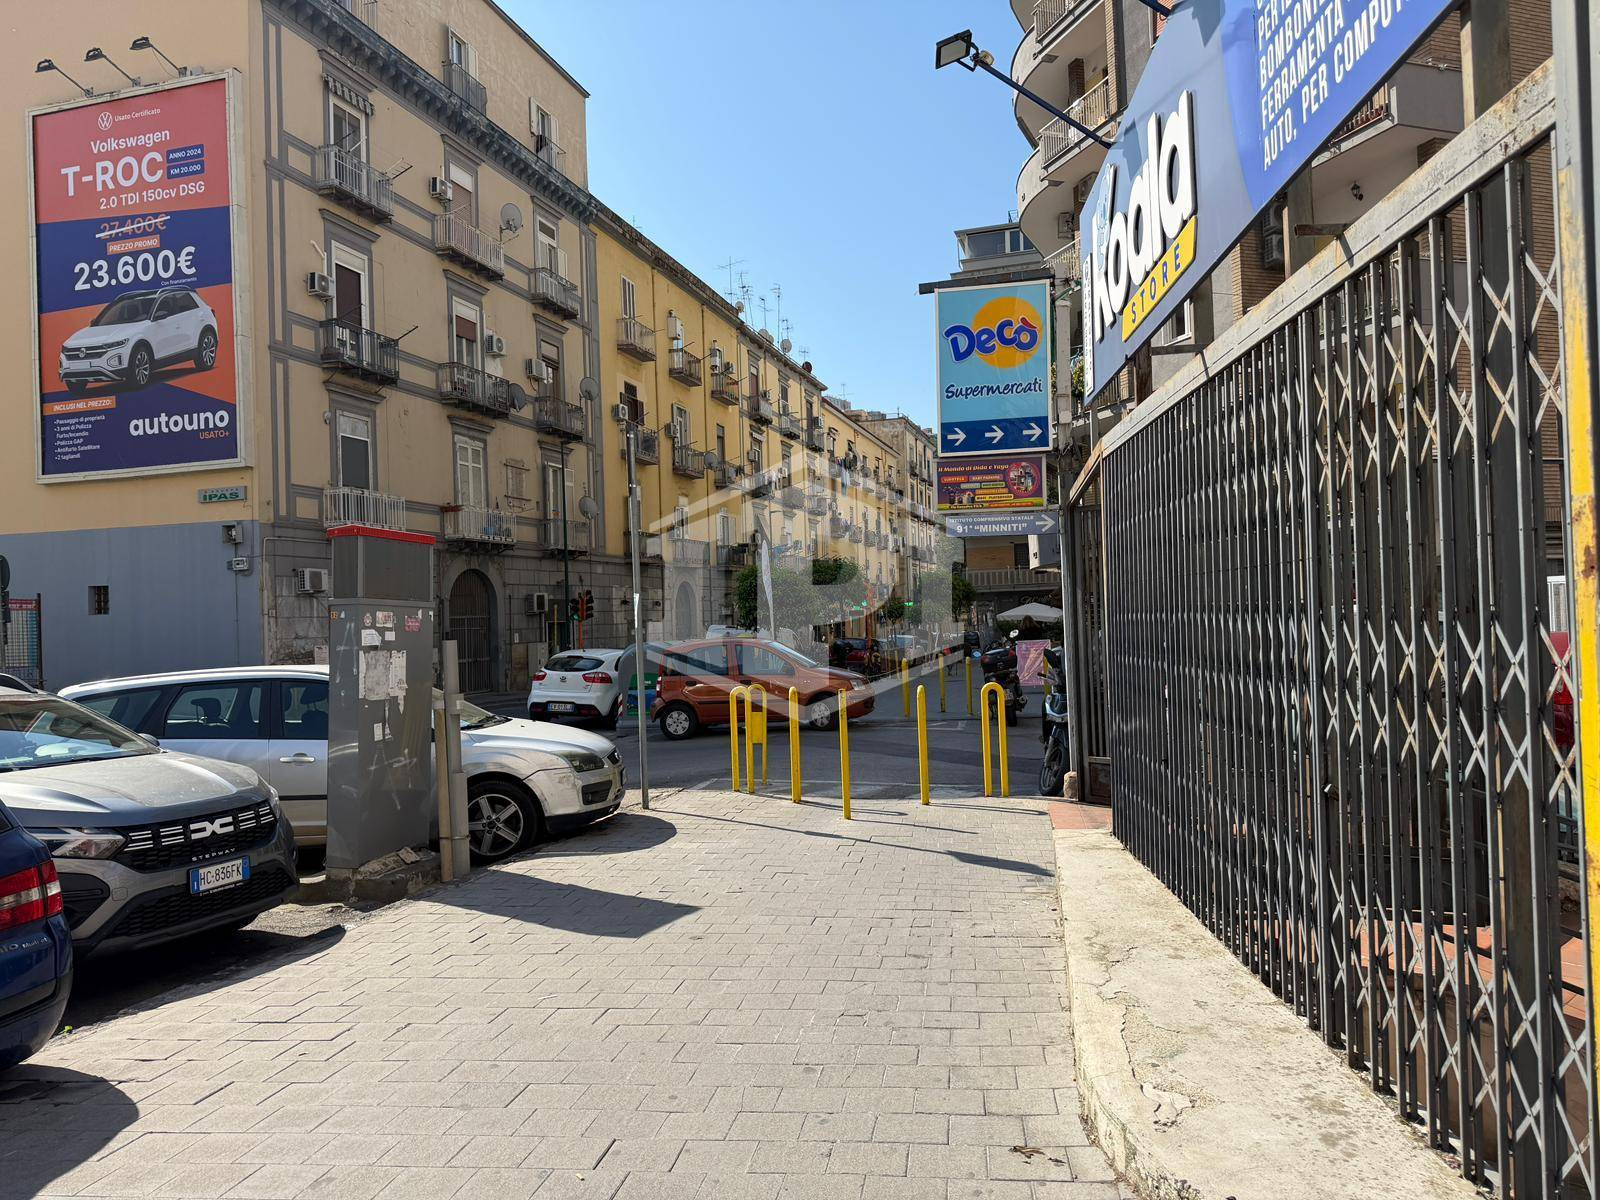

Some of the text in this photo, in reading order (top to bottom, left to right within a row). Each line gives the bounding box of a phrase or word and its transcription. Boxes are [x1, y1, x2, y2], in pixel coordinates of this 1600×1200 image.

[1261, 0, 1344, 131] FERRAMENTA
[115, 108, 160, 122] Usato Certificato
[1264, 107, 1297, 171] AUTO,
[1302, 63, 1328, 124] PER
[91, 129, 170, 154] Volkswagen
[169, 147, 202, 160] ANNO 2024
[61, 152, 163, 196] T-ROC
[180, 164, 201, 174] 20.000
[100, 181, 205, 209] 2.0 TDI 150cv DSG
[100, 214, 167, 239] 27.400€
[109, 239, 158, 252] PREZZO PROMO
[74, 246, 196, 291] 23.600€
[1130, 242, 1181, 325] STORE
[945, 377, 1042, 400] Supermercati
[53, 402, 75, 411] INCLUSI
[88, 400, 112, 408] PREZZO:
[129, 410, 229, 436] autouno
[199, 430, 229, 439] USATO+
[192, 848, 235, 862] STEPWAY
